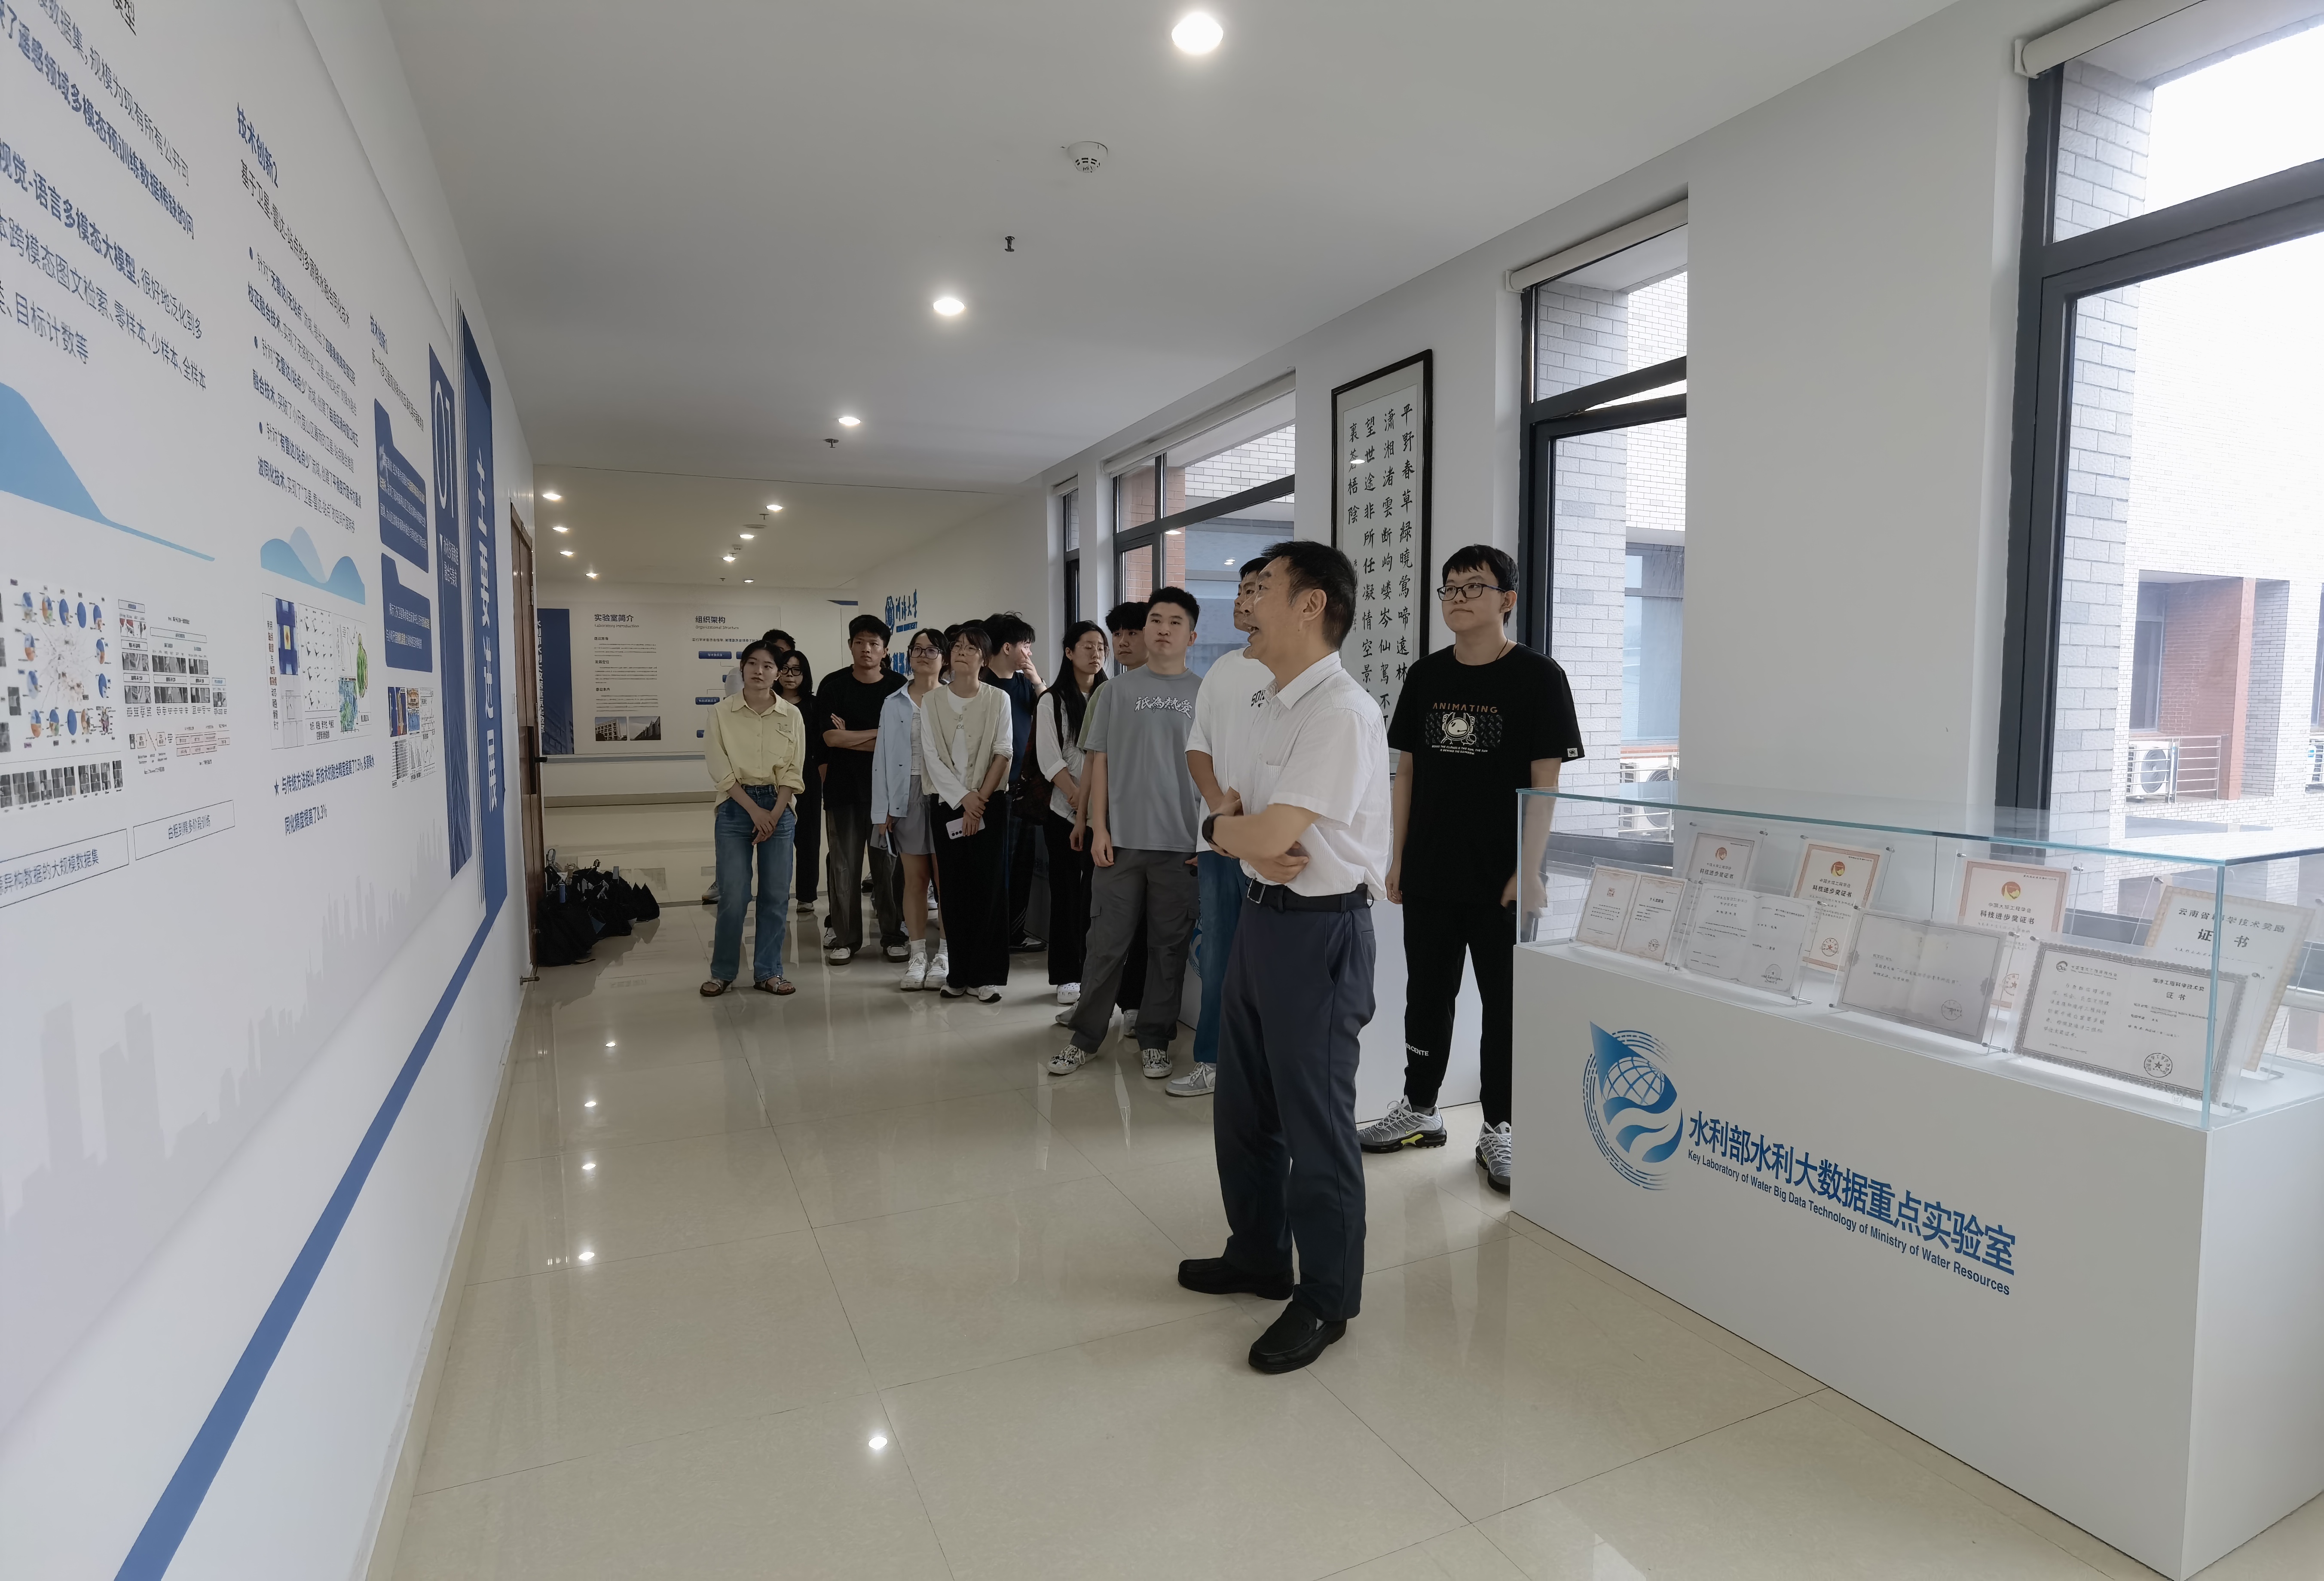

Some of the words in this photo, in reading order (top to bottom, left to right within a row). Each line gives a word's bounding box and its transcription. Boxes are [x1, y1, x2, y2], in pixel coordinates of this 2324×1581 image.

[237, 102, 278, 188] 技术创新2
[434, 380, 454, 518] 01
[1361, 416, 1376, 693] 望世途非所任凝情空景
[477, 447, 497, 814] 主要进展
[594, 614, 634, 622] 实验室简介
[695, 616, 726, 624] 组织架构
[1432, 702, 1498, 713] ANIMATING
[1980, 910, 2035, 925] 科技进步奖证书
[1688, 1149, 1700, 1164] Key
[1703, 1154, 1740, 1182] Laboratory
[1741, 1172, 1749, 1183] of
[1750, 1175, 1772, 1192] Water
[1774, 1185, 1786, 1203] Big
[1789, 1192, 1806, 1209] Data
[1808, 1200, 1856, 1233] Technology
[1859, 1224, 1868, 1235] of
[1871, 1226, 1907, 1253] Ministry
[1910, 1245, 1919, 1255] of
[1922, 1247, 1950, 1270] Water
[1953, 1262, 2010, 1295] Resources
[1689, 1111, 2015, 1276] 水利部水利大数据重点实验室
